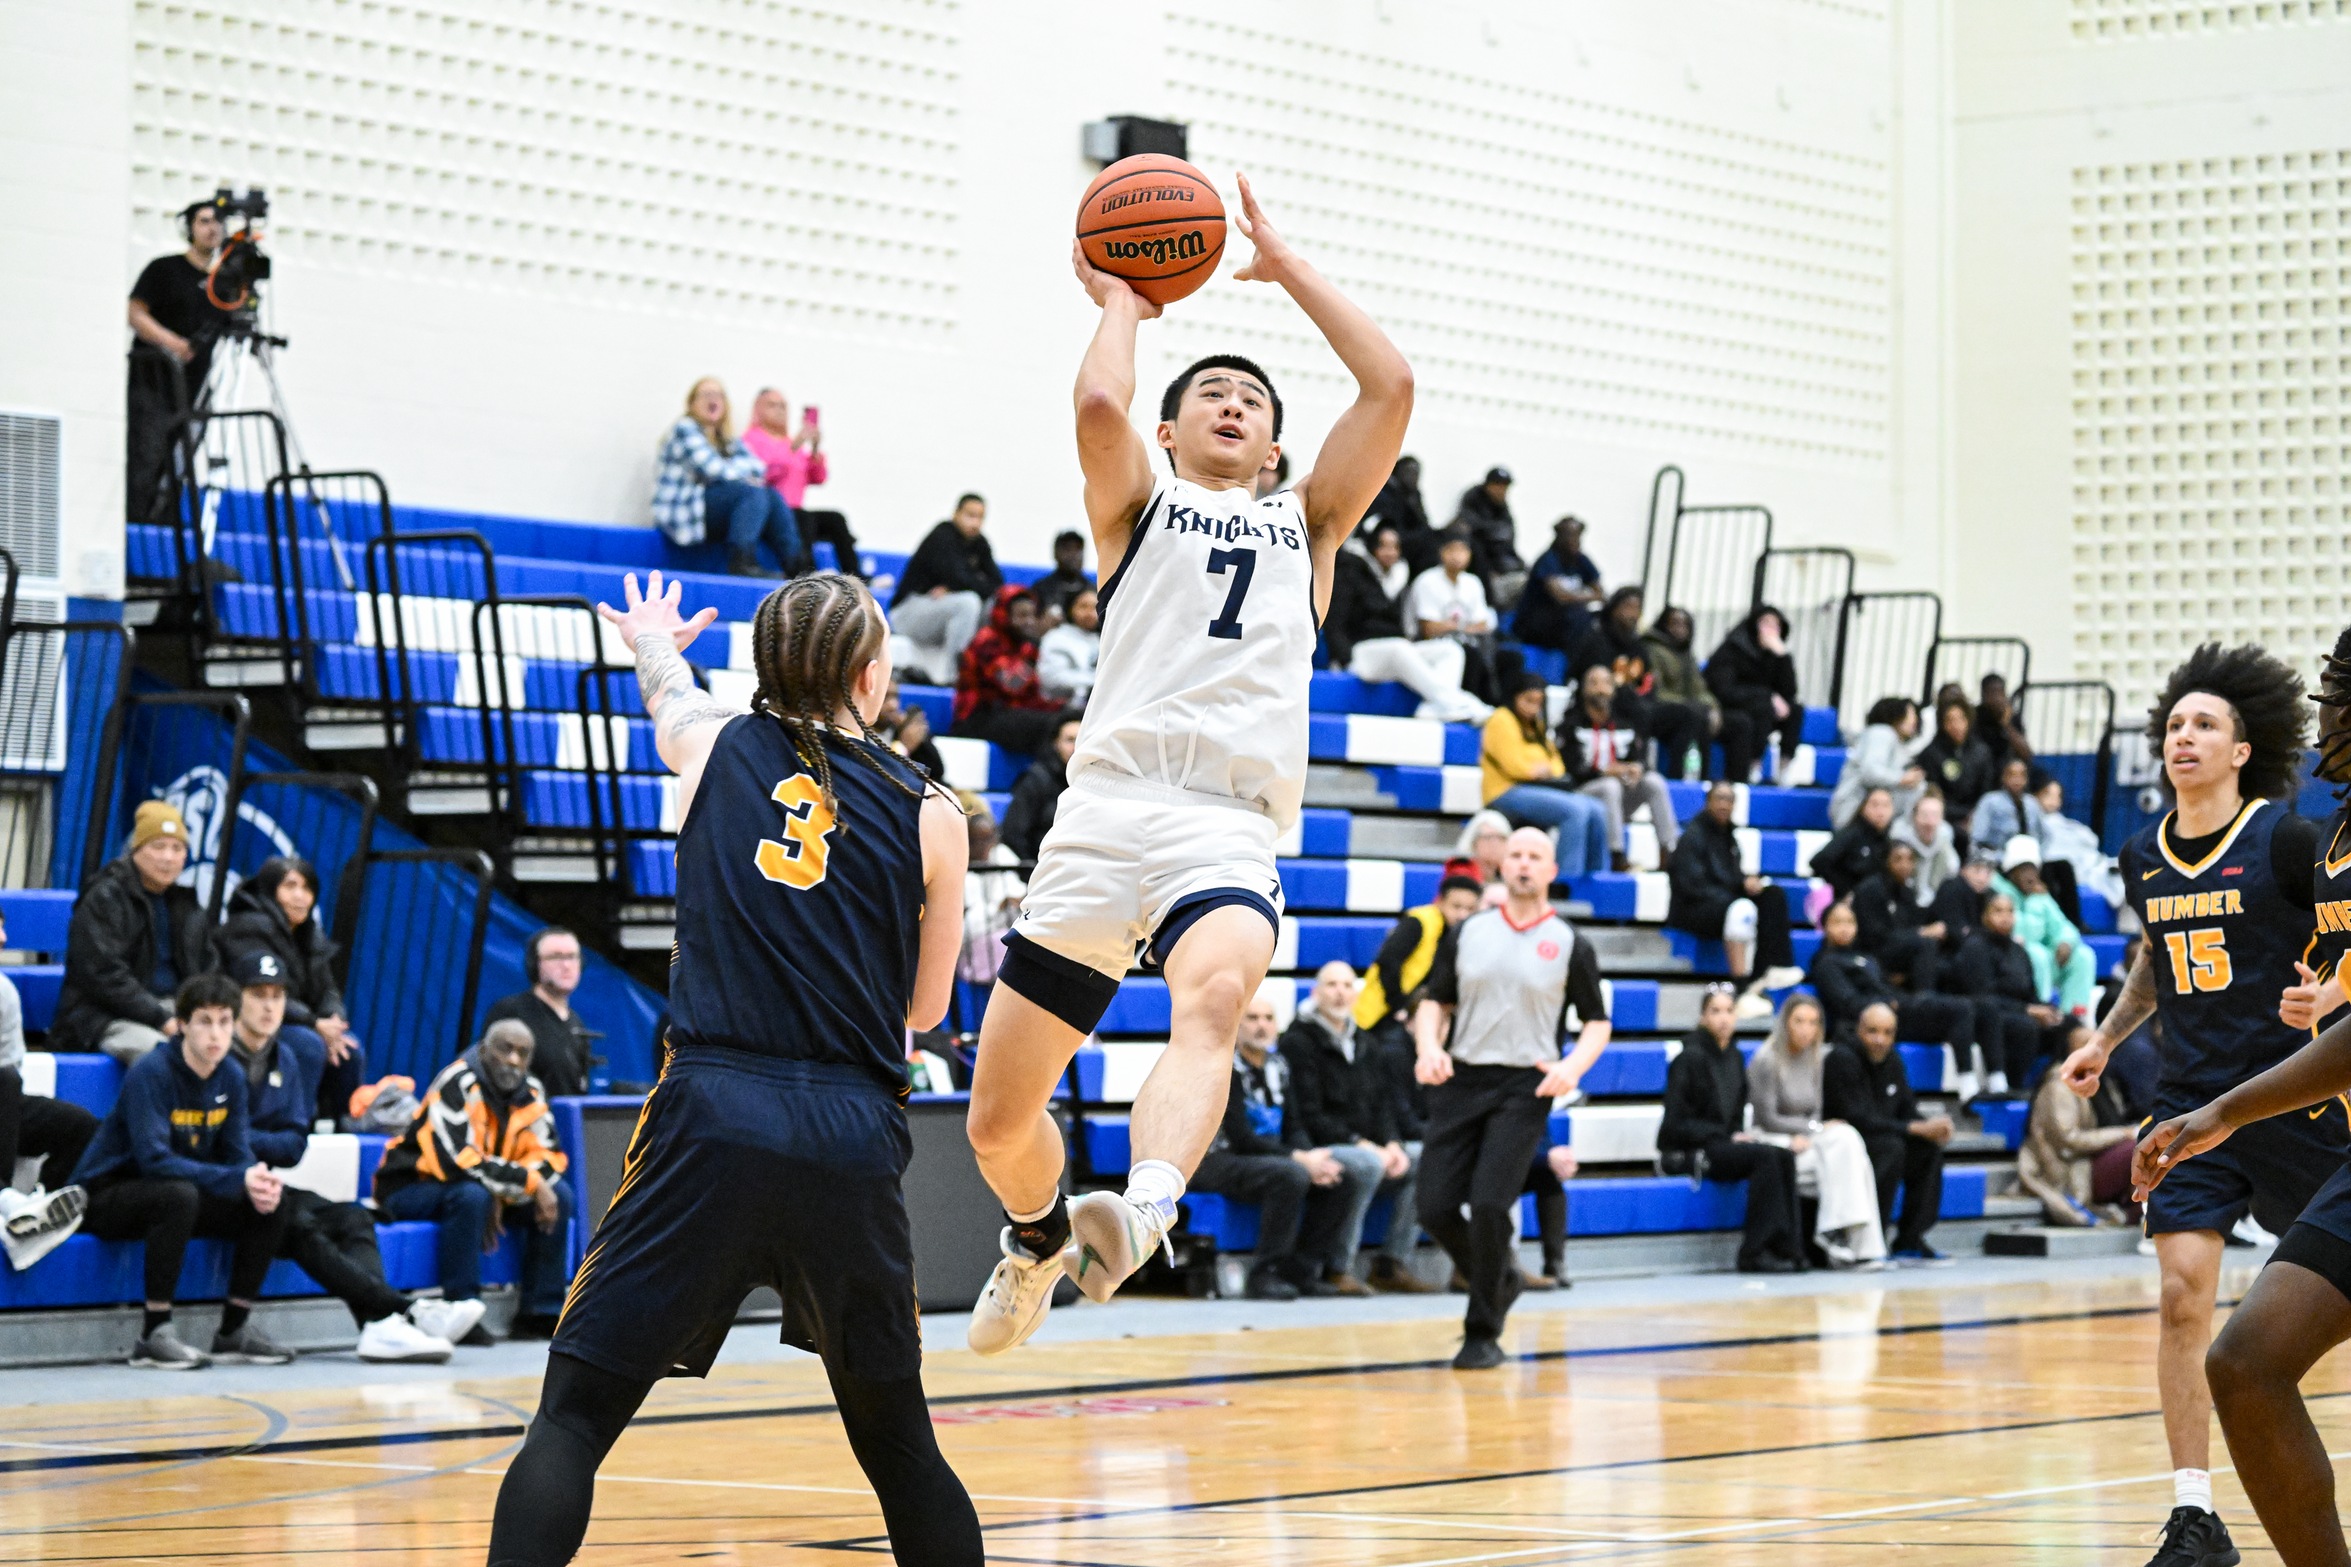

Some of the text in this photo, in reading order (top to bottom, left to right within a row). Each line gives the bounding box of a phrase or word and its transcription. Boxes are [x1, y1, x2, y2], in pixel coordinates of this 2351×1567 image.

[1101, 189, 1194, 214] EVOLUTION
[1104, 230, 1206, 265] Wilson
[1164, 504, 1300, 550] KNIGHTS
[1206, 547, 1257, 640] 7
[753, 772, 838, 891] 3
[2146, 888, 2244, 924] HUMBER
[2314, 899, 2351, 935] UMBE
[2163, 927, 2233, 995] 15
